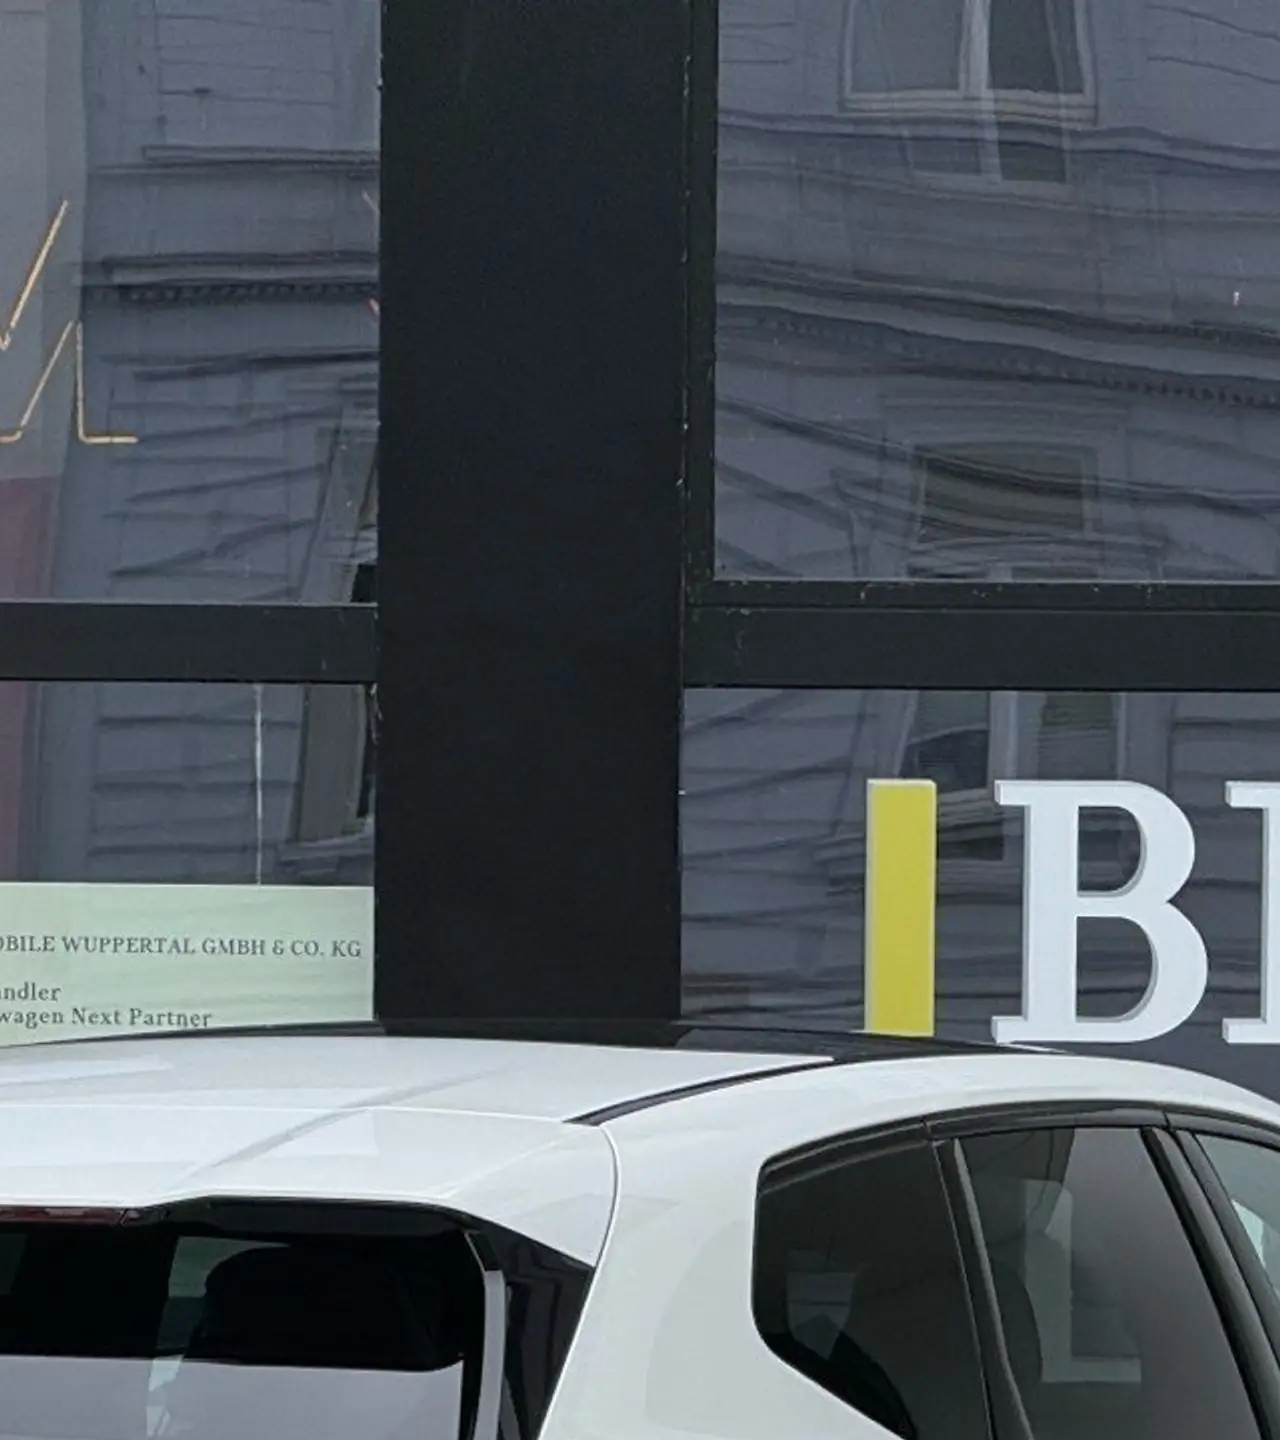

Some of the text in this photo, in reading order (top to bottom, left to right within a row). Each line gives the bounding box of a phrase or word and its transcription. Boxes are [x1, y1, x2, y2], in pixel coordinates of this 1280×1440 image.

[62, 936, 195, 955] WUPPERTAL
[202, 938, 265, 956] GMBH
[272, 939, 285, 957] &
[290, 939, 325, 957] CO.
[331, 940, 362, 957] KG
[71, 1007, 122, 1026] Next
[129, 1008, 213, 1028] Partner
